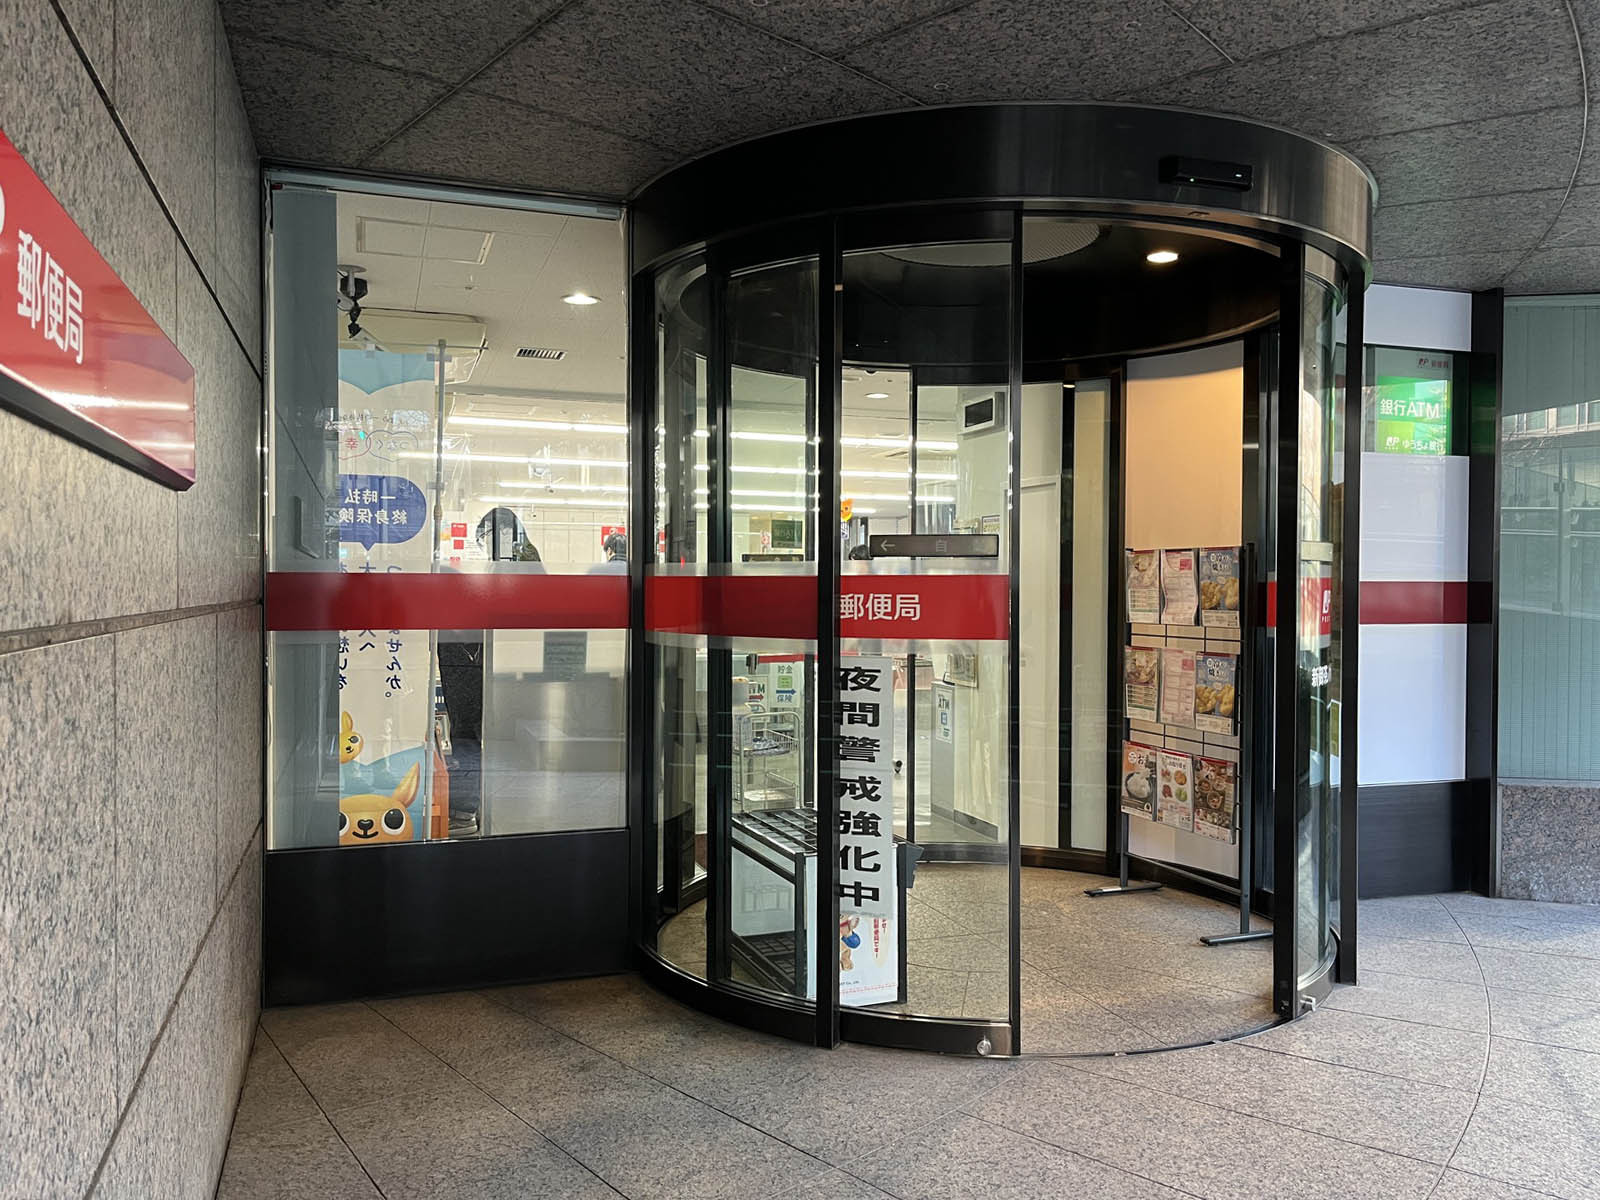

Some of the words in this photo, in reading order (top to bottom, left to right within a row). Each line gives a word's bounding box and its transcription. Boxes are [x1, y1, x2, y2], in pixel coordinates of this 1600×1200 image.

[17, 229, 84, 365] 郵便局
[1380, 398, 1441, 418] 銀行ATM
[840, 593, 921, 621] 郵便局
[840, 666, 882, 907] 夜間警戒強化中
